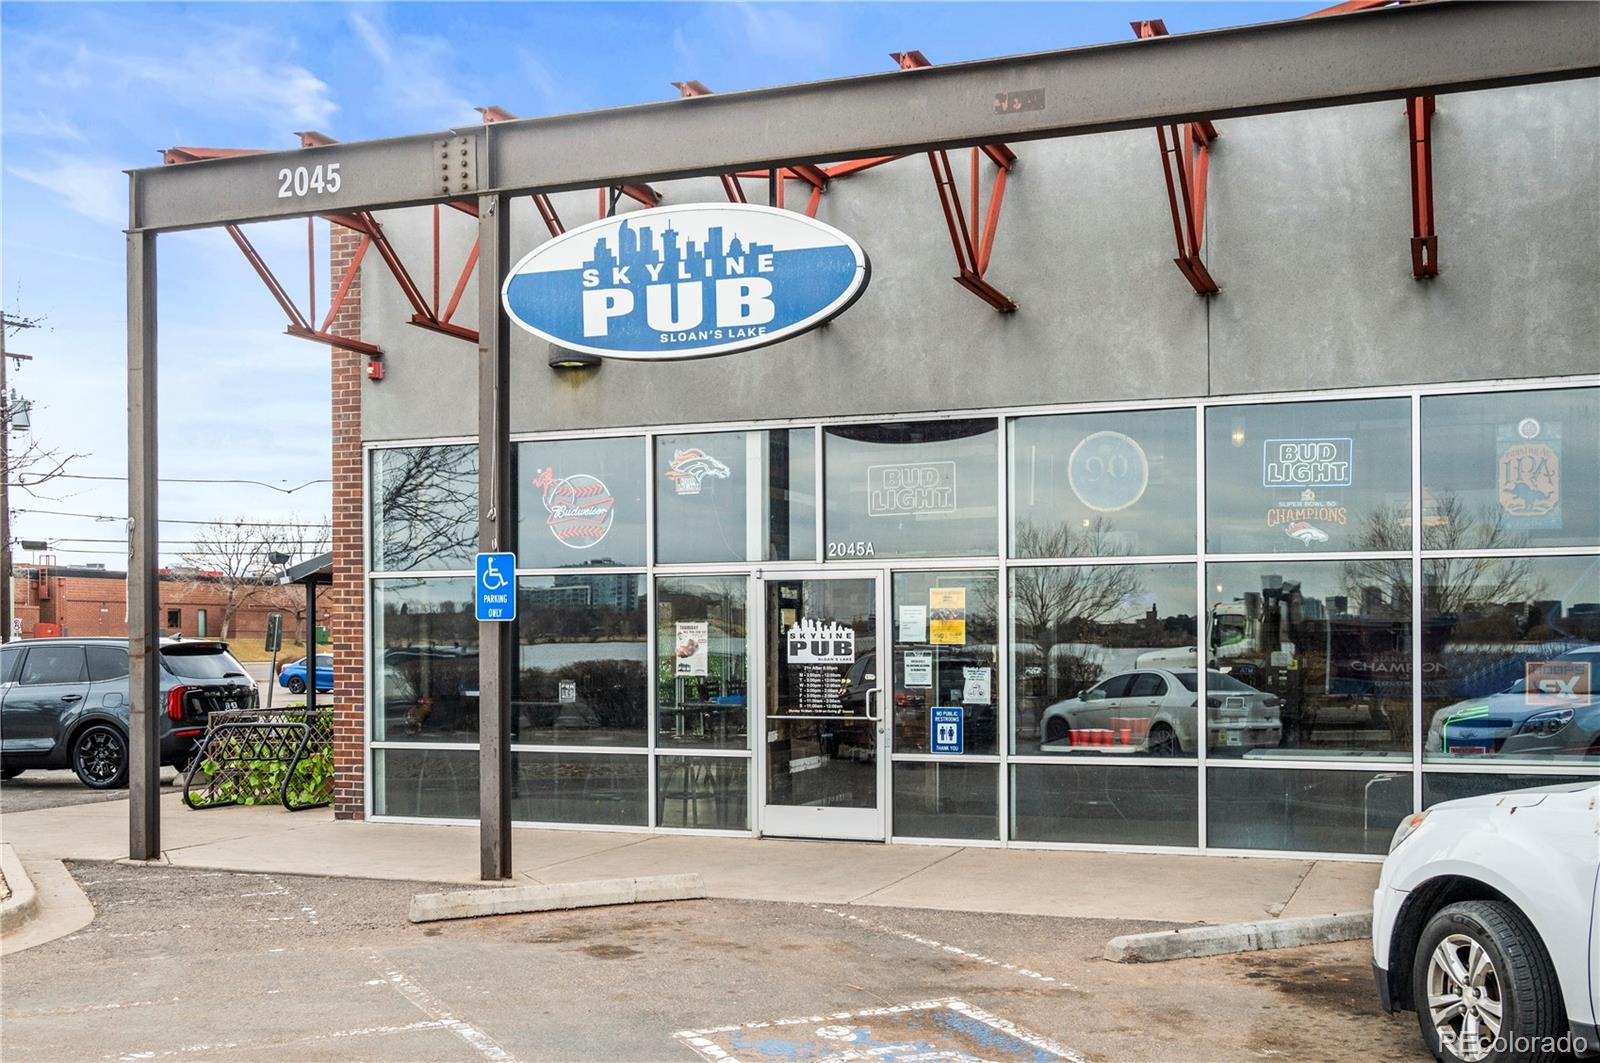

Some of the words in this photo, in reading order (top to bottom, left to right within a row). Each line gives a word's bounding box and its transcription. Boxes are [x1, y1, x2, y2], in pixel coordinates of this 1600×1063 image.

[278, 163, 341, 198] 2045
[582, 253, 774, 288] SKYLINE
[582, 277, 776, 338] PUB
[660, 329, 723, 344] SLOAN'S
[728, 326, 767, 340] LAKE
[1280, 443, 1337, 463] BUD
[883, 467, 940, 489] BUD
[1268, 462, 1349, 482] LIGHT
[1504, 456, 1556, 484] IPA
[872, 487, 953, 511] LIGHT
[551, 505, 608, 518] Budweiser
[1267, 507, 1347, 528] CHAMPIONS
[828, 541, 876, 557] 2045A
[483, 594, 508, 604] PARKING
[488, 608, 503, 617] ONLY
[790, 641, 853, 656] PUB
